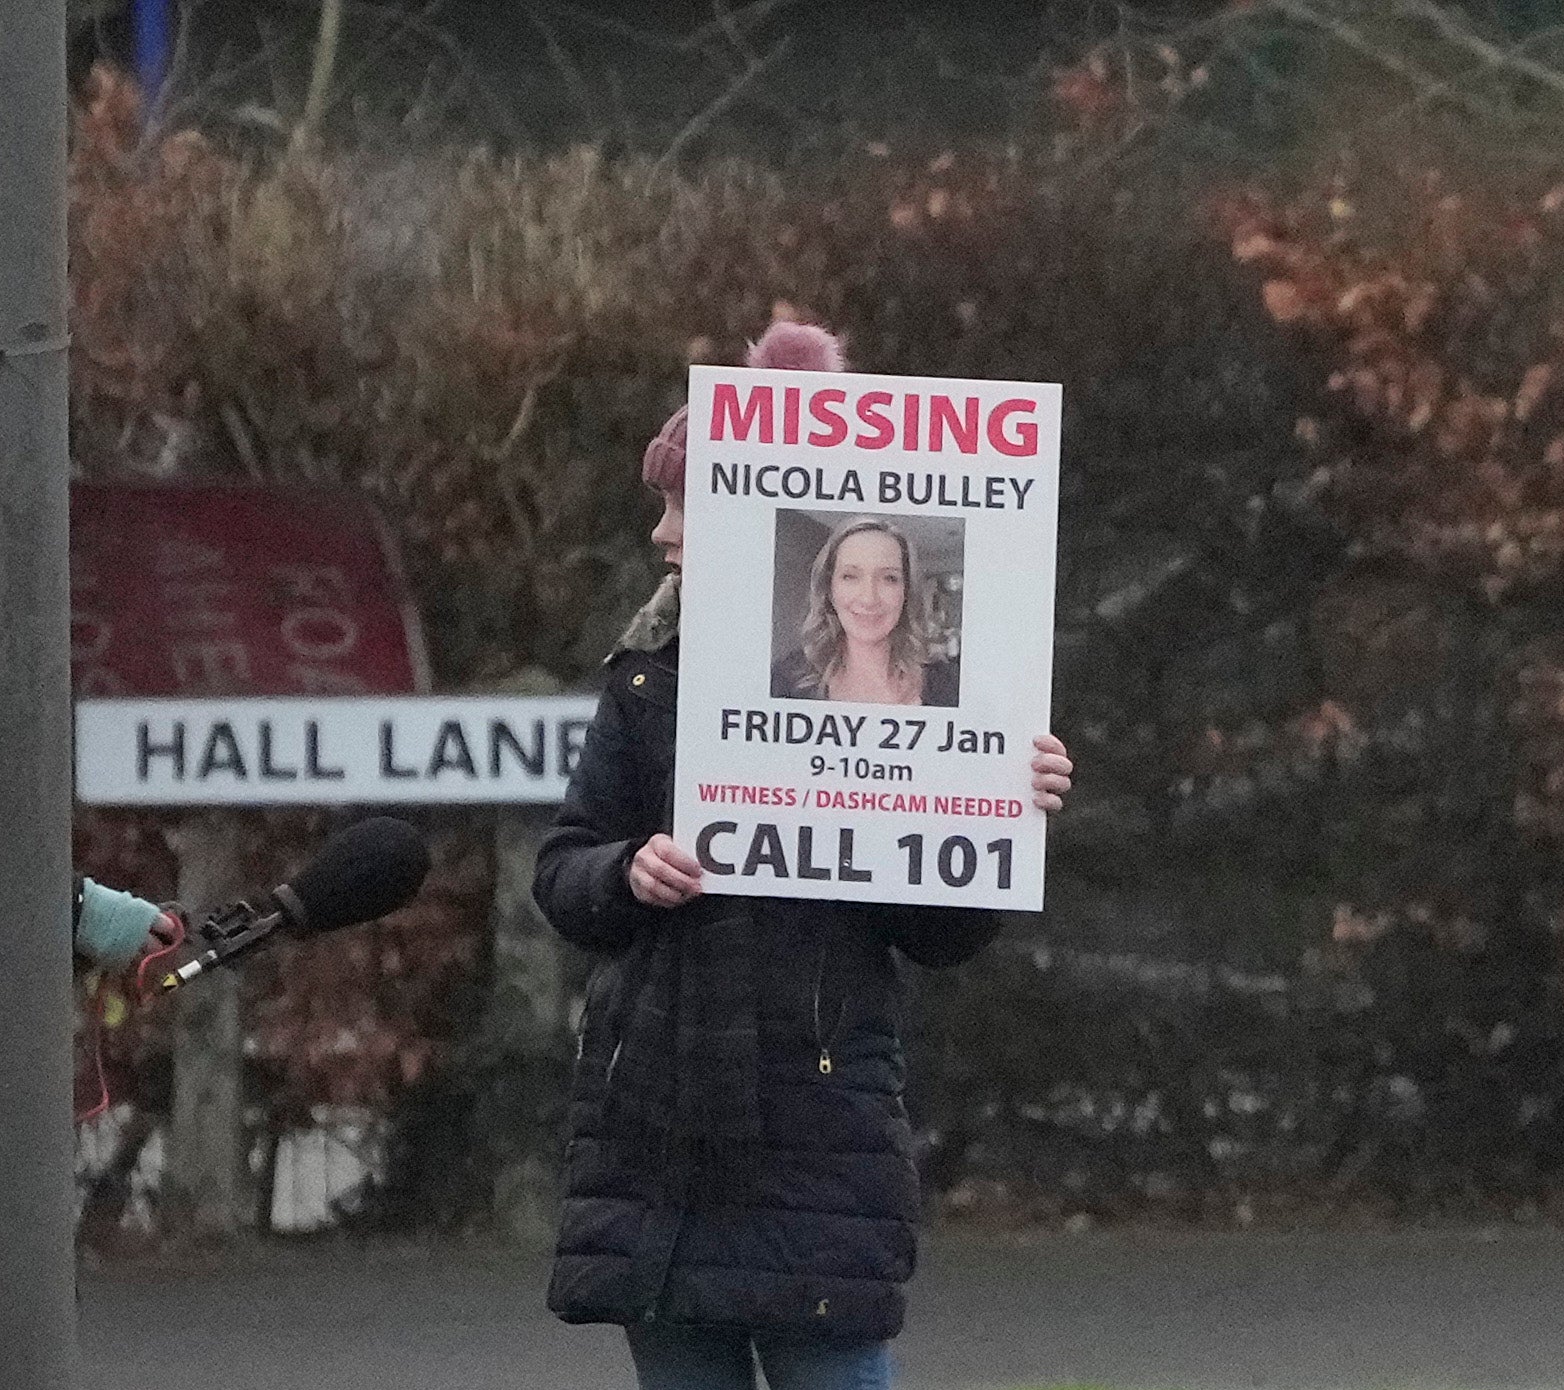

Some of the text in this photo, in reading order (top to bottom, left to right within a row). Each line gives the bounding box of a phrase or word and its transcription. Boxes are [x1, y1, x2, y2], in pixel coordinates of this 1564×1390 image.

[709, 383, 1038, 457] MISSING
[711, 462, 1035, 510] NICOLA BULLEY
[136, 718, 346, 781] HALL
[721, 709, 1006, 755] FRIDAY 27 Jan
[810, 755, 914, 782] 9-10am
[698, 783, 798, 808] WITNESS
[816, 790, 928, 814] DASHCAM
[934, 796, 1024, 819] NEEDED
[695, 820, 1014, 890] CALL 101
